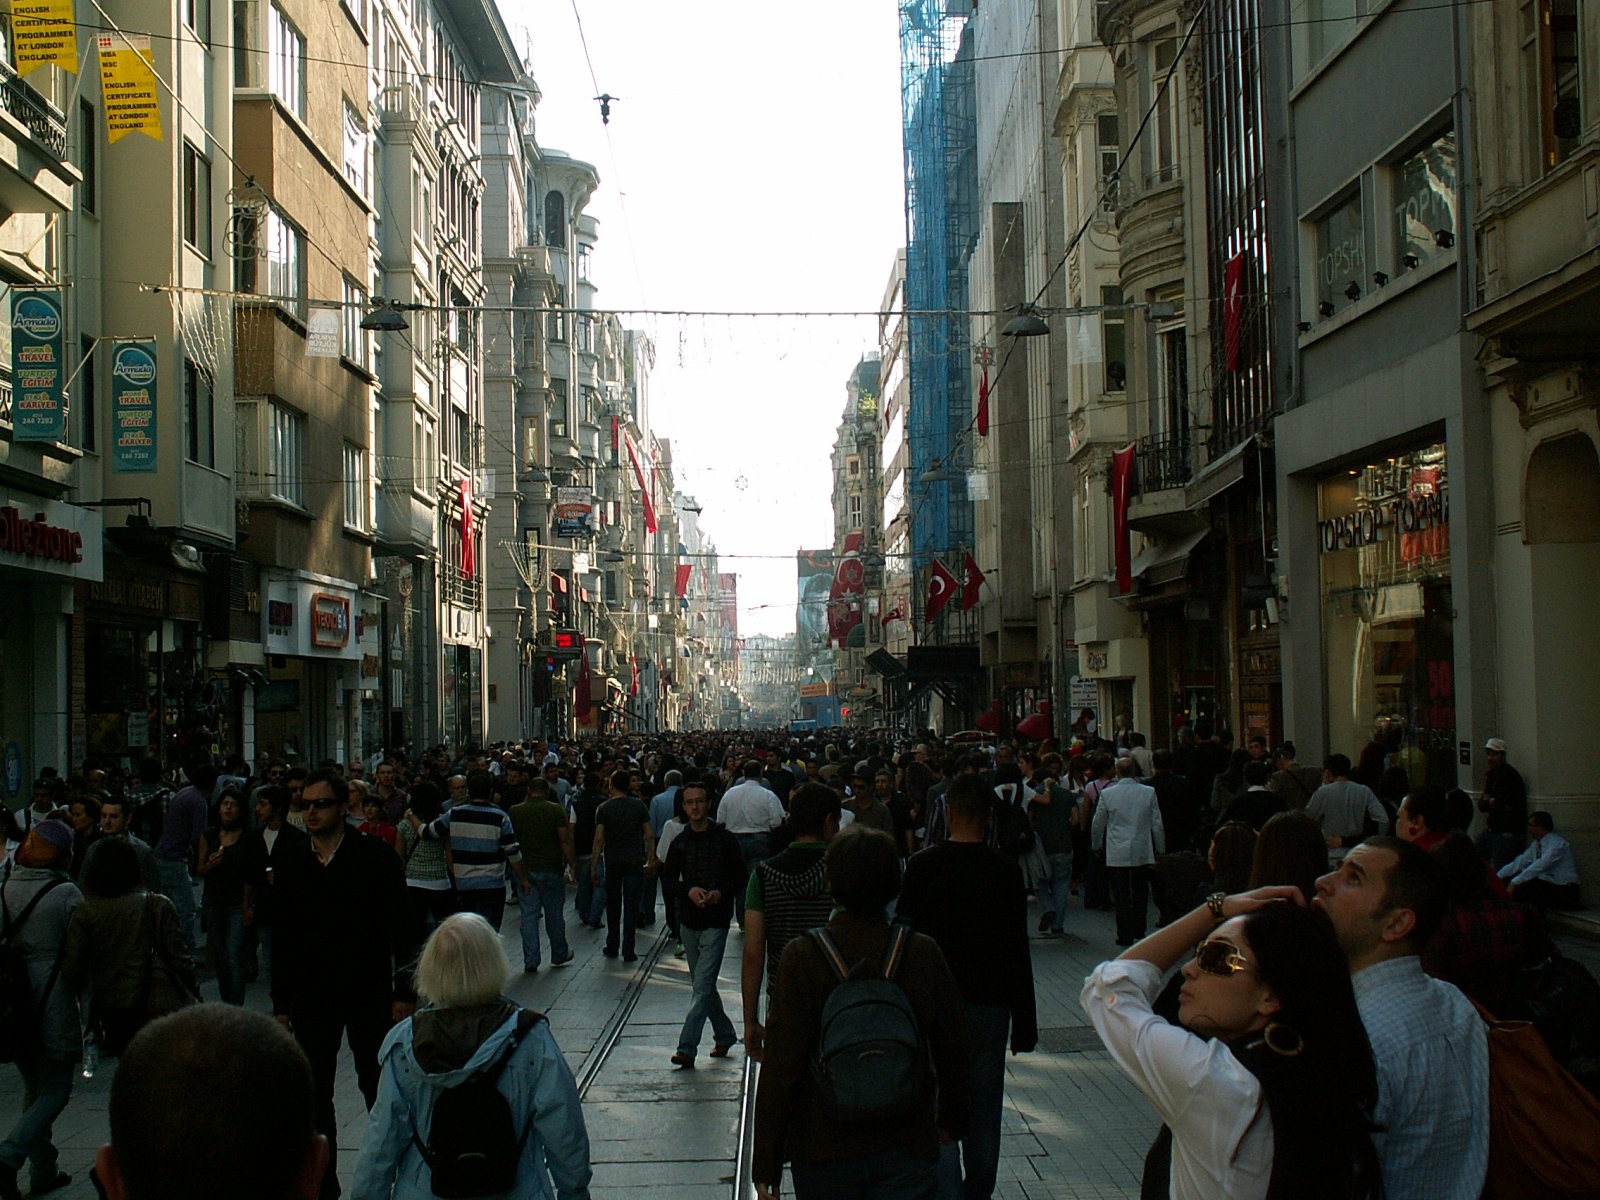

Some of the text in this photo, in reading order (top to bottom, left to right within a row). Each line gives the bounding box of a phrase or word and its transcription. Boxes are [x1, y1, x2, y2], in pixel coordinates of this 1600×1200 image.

[14, 6, 50, 14] ENGLISH
[15, 18, 68, 27] CERTIFICATE
[16, 30, 74, 39] PROGRAMMES
[30, 42, 64, 50] LONDON
[18, 53, 58, 61] ENGLAND
[106, 92, 152, 100] CERTIFICATE
[107, 103, 157, 111] PROGRAMMES
[109, 122, 144, 130] ENGLAND
[14, 314, 56, 327] Armada
[20, 353, 55, 361] TRAVEL
[115, 364, 152, 373] Armada
[20, 401, 56, 409] KARİYER
[1317, 505, 1383, 553] TOPSHOP
